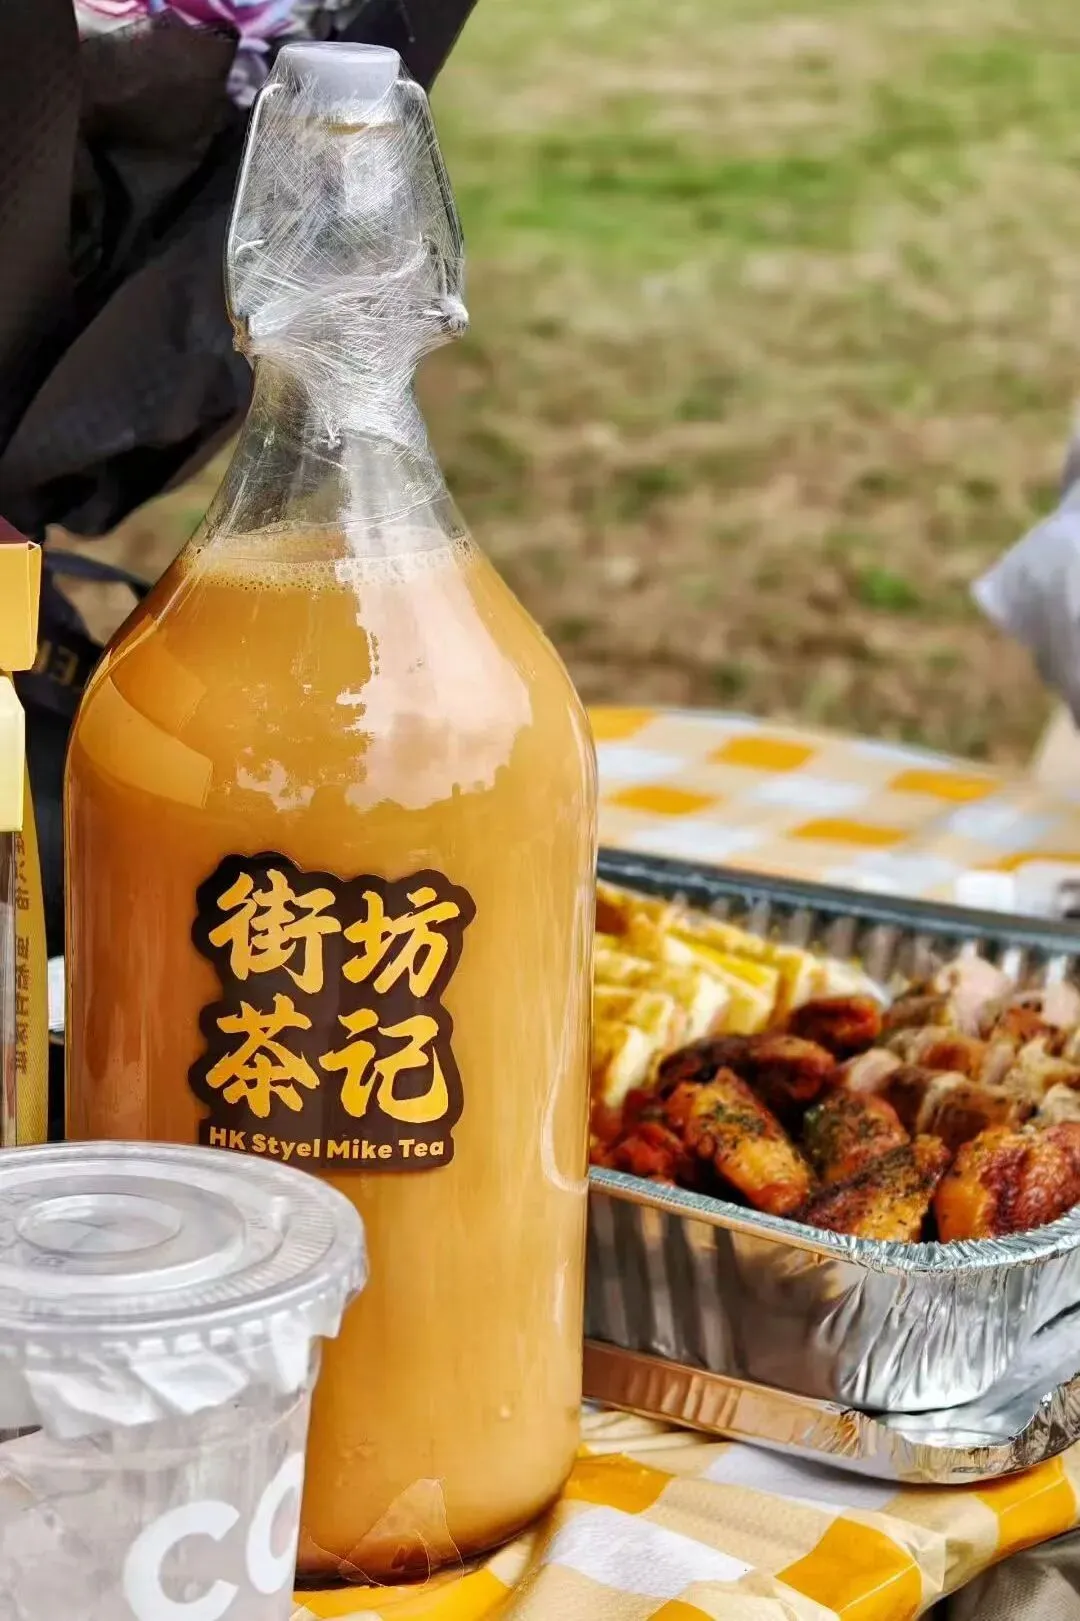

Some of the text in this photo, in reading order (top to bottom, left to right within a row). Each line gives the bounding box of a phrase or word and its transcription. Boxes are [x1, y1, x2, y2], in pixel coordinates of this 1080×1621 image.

[208, 868, 461, 998] 街坊
[205, 992, 449, 1124] 茶记
[209, 1126, 445, 1161] HK Styel Mike Tea
